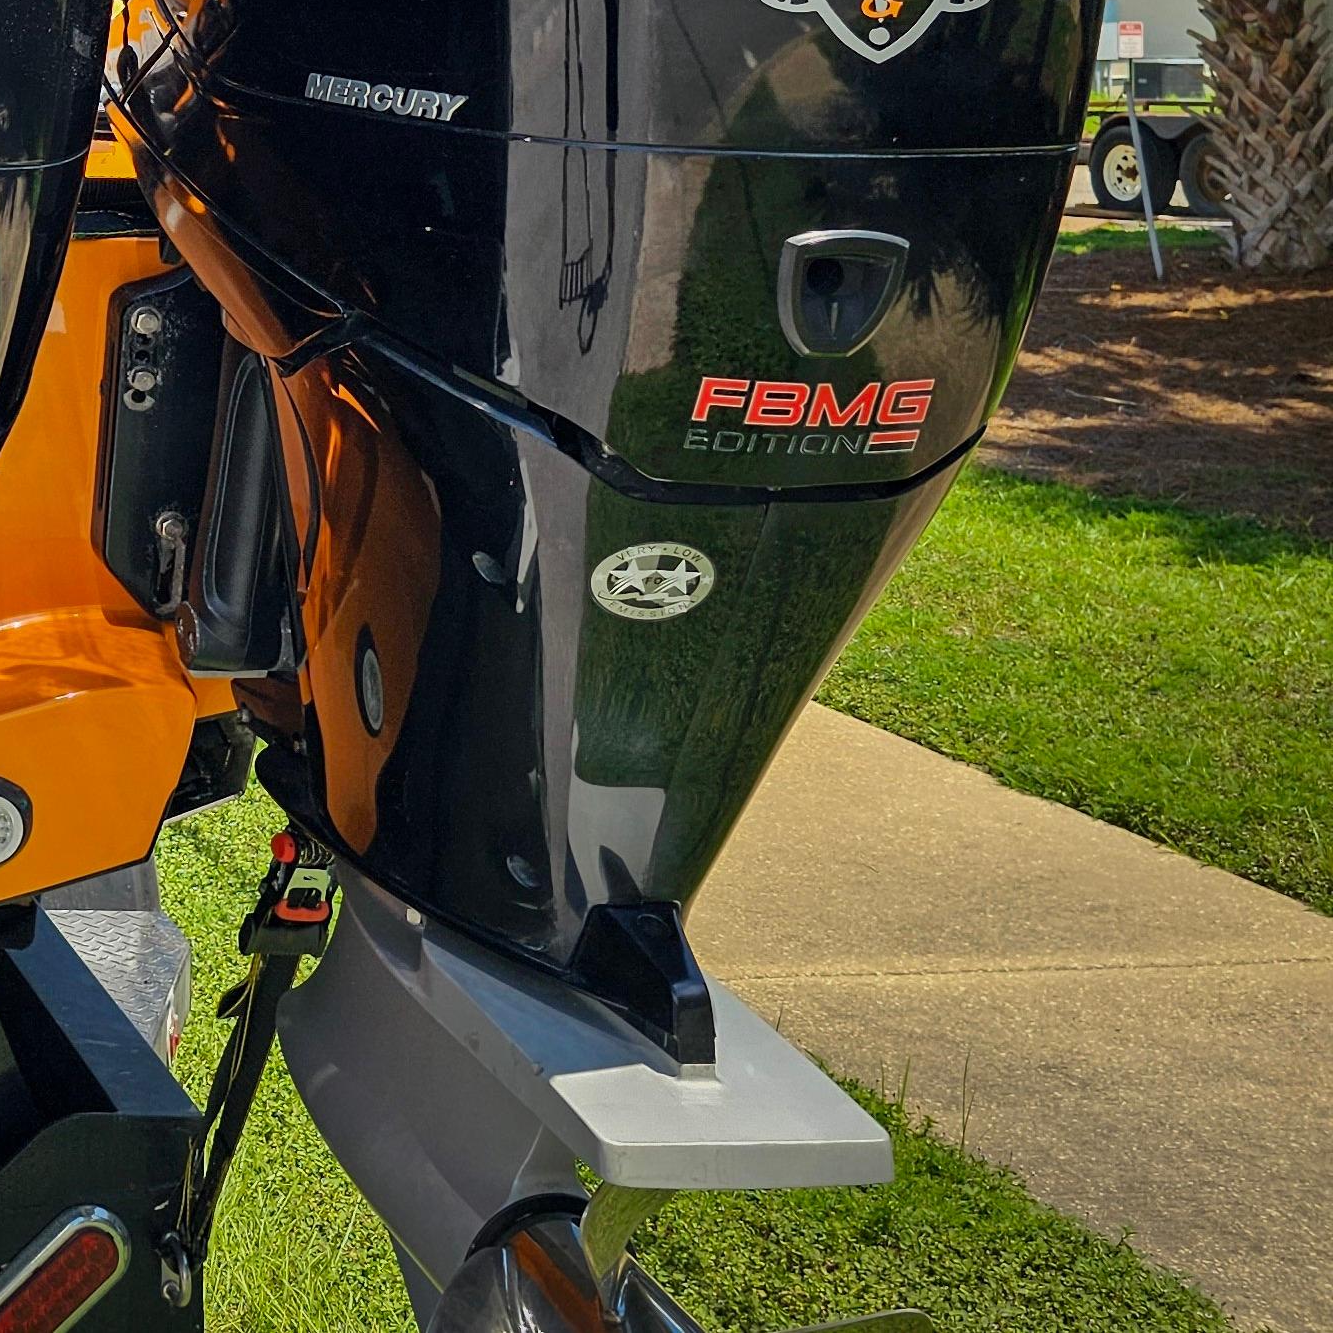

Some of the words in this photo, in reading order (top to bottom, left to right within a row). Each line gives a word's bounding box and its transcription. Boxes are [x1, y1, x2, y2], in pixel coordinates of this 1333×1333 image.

[304, 72, 469, 122] MERCURY
[691, 376, 935, 427] FBMG
[683, 428, 866, 455] EDITION
[615, 545, 657, 561] VERY
[673, 546, 704, 563] LOW
